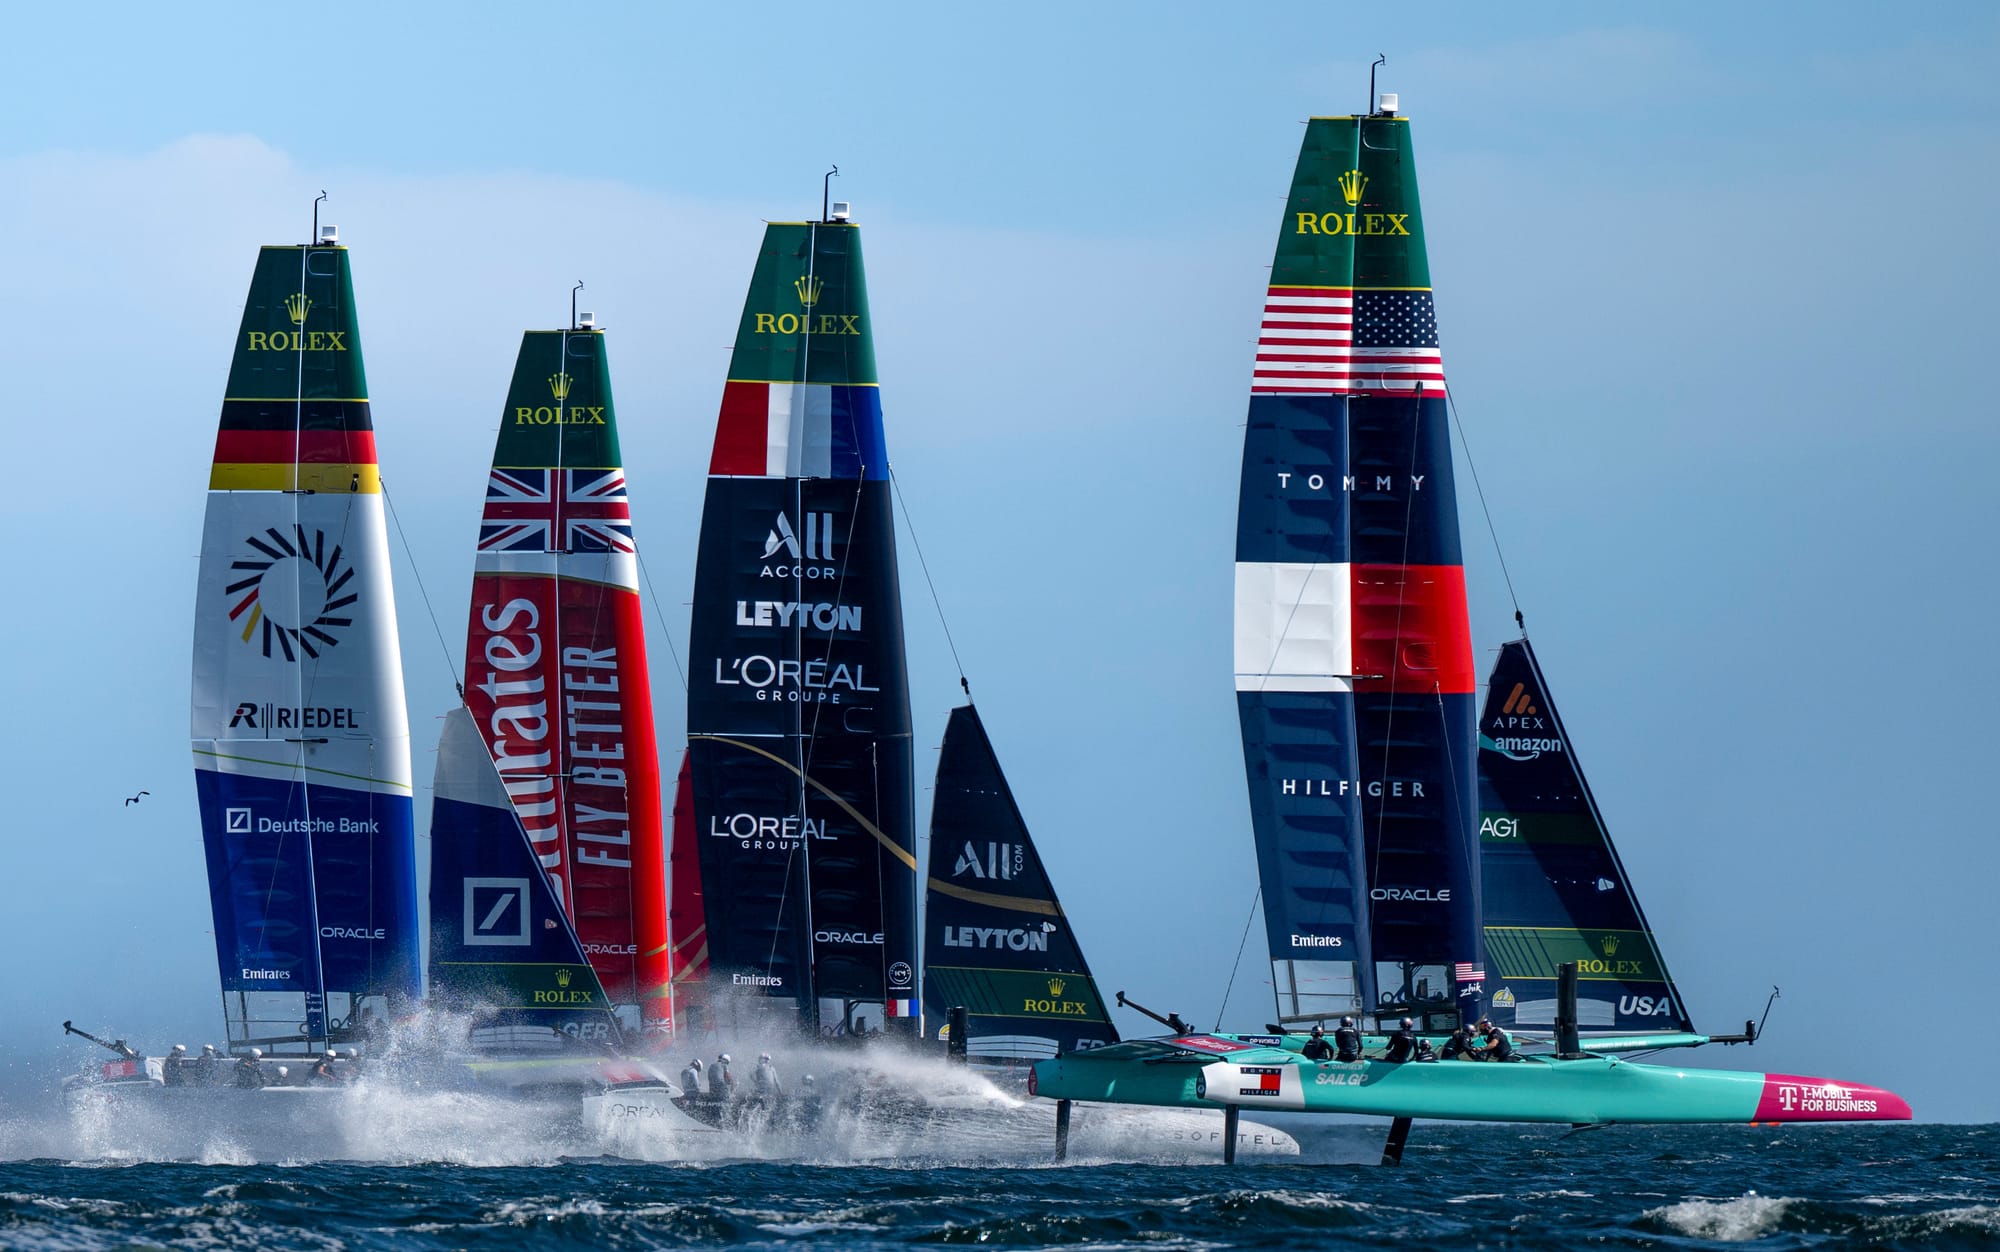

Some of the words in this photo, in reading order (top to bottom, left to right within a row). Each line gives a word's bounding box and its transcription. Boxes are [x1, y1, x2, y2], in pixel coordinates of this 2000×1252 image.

[1296, 212, 1410, 236] ROLEX
[754, 313, 861, 335] ROLEX
[247, 331, 347, 351] ROLEX
[515, 406, 605, 425] ROLEX
[1278, 473, 1424, 491] TOMMY
[760, 565, 836, 580] ACCOR
[736, 600, 862, 632] LEYTON
[715, 655, 880, 692] L'ORÉAL
[756, 690, 841, 704] GROUPE
[277, 708, 359, 729] RIEDEL
[563, 647, 626, 787] BETTER
[1493, 717, 1544, 729] APEX
[1495, 737, 1562, 752] amazon
[476, 598, 567, 911] mirates
[1282, 779, 1425, 797] HILFIGER
[258, 817, 335, 833] Deutsche
[339, 817, 379, 833] Bank
[711, 813, 838, 840] L'ORÉAL
[1479, 817, 1518, 838] AG1
[574, 803, 632, 868] FLY
[1370, 888, 1451, 901] ORACLE
[320, 927, 386, 940] ORACLE
[814, 931, 886, 945] ORACLE
[944, 925, 1048, 952] LEYTON
[1291, 935, 1342, 947] Emirates
[242, 968, 291, 980] Emirates
[1576, 959, 1644, 975] ROLEX
[732, 973, 782, 987] Emirates
[533, 990, 593, 1003] ROLEX
[1460, 982, 1483, 998] zhik
[1023, 999, 1088, 1016] ROLEX
[1619, 995, 1672, 1017] USA
[563, 1021, 609, 1041] GER
[1801, 1086, 1852, 1100] T-MOBILE
[1801, 1100, 1824, 1112] FOR
[1825, 1100, 1878, 1113] BUSINESS
[1173, 1128, 1281, 1146] SOFTEL
